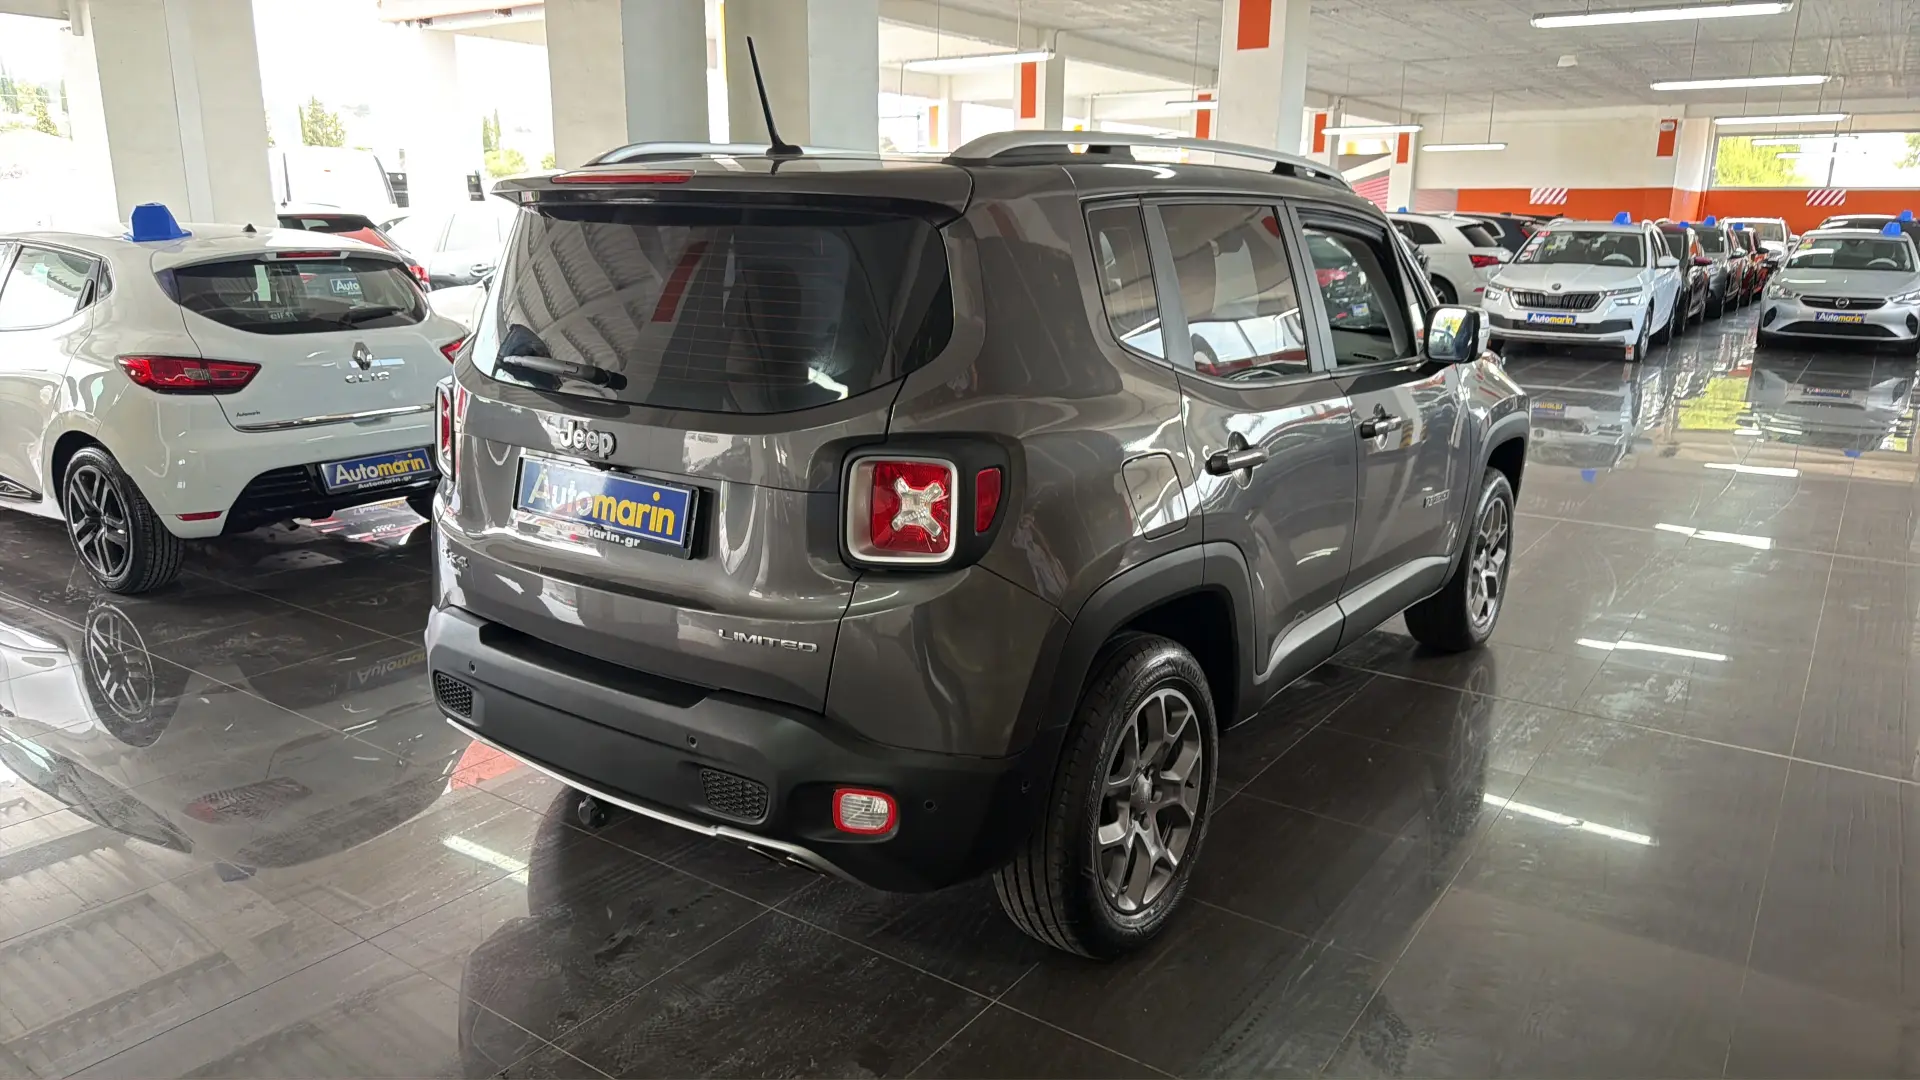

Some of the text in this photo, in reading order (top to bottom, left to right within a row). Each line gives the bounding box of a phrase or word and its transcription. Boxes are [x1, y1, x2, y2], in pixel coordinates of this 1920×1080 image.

[1530, 313, 1573, 325] Automarin
[1819, 313, 1862, 323] Automarin
[345, 371, 389, 384] CLIO
[560, 420, 616, 459] Jeep
[336, 452, 425, 484] Automarin
[528, 466, 676, 536] Automarin
[718, 628, 818, 653] LIMITED
